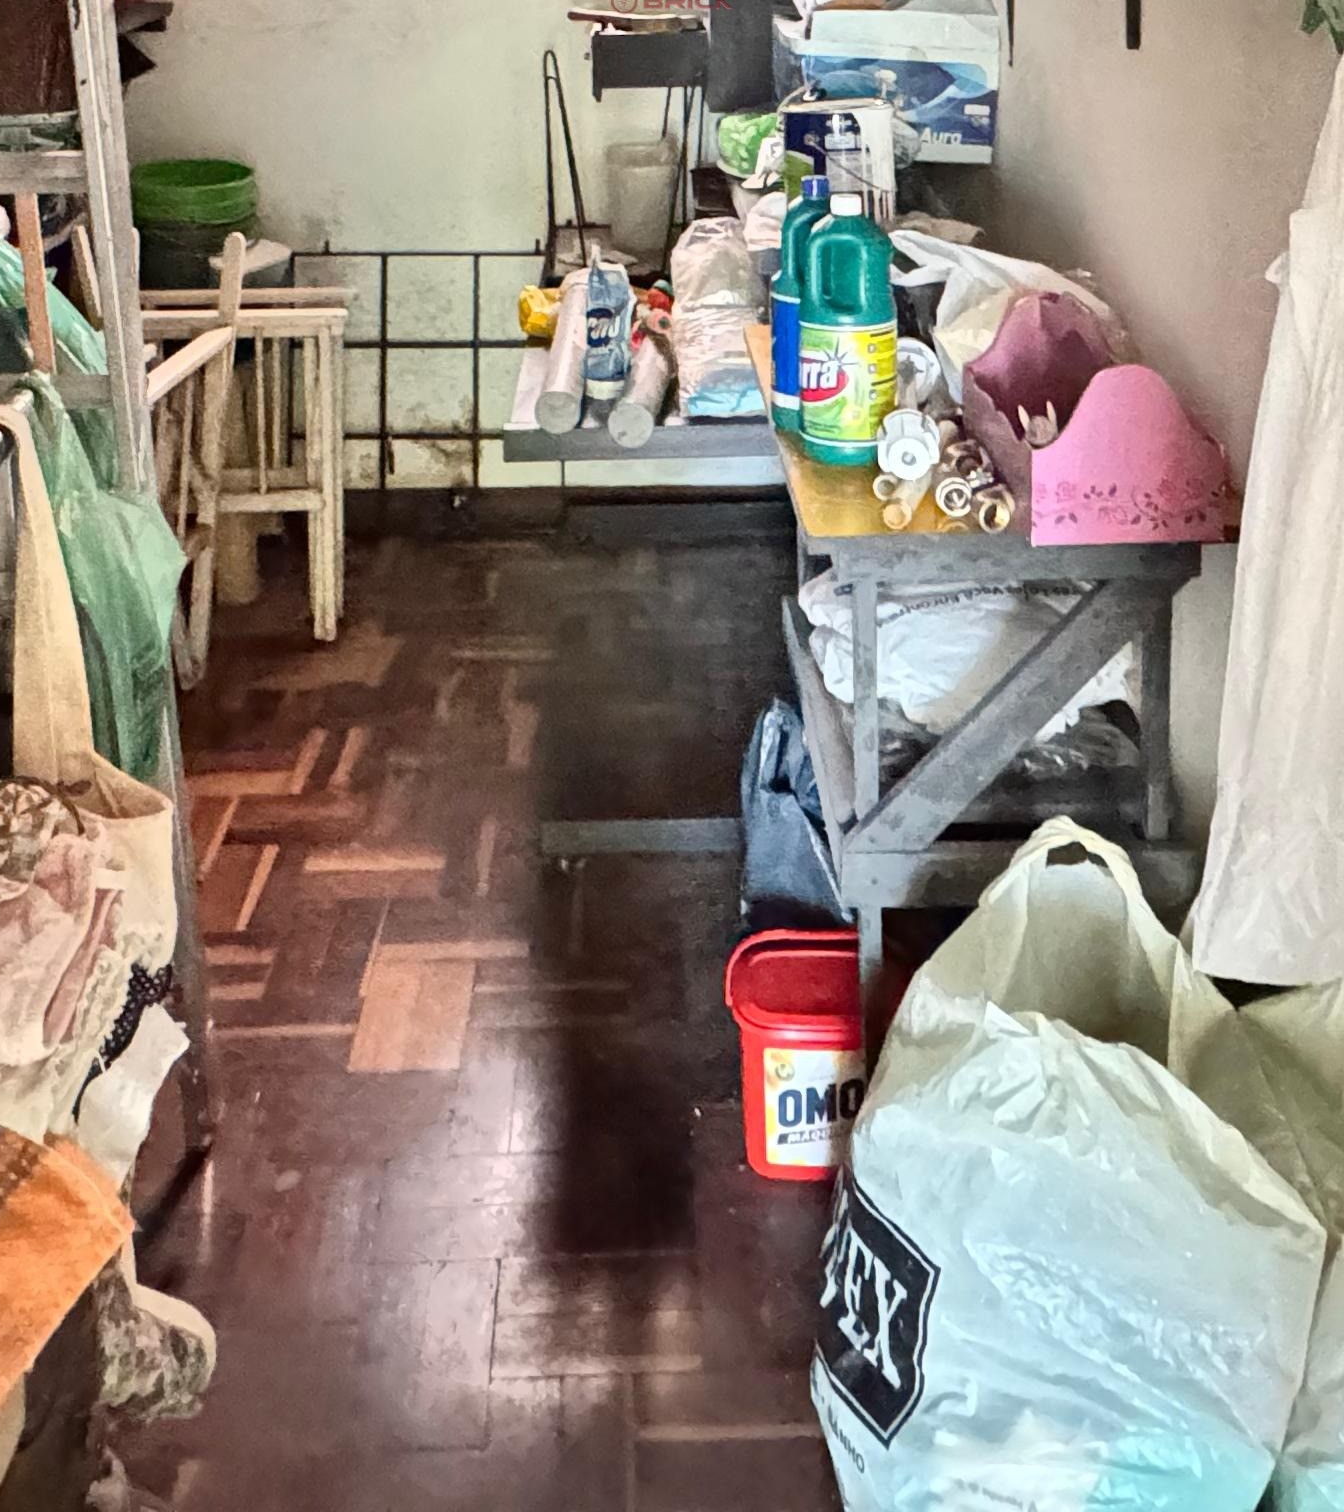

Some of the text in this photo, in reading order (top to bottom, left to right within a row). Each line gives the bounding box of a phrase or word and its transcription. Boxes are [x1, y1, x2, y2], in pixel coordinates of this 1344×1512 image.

[920, 126, 963, 145] Aura
[800, 359, 840, 390] rra
[778, 1078, 865, 1128] OMO
